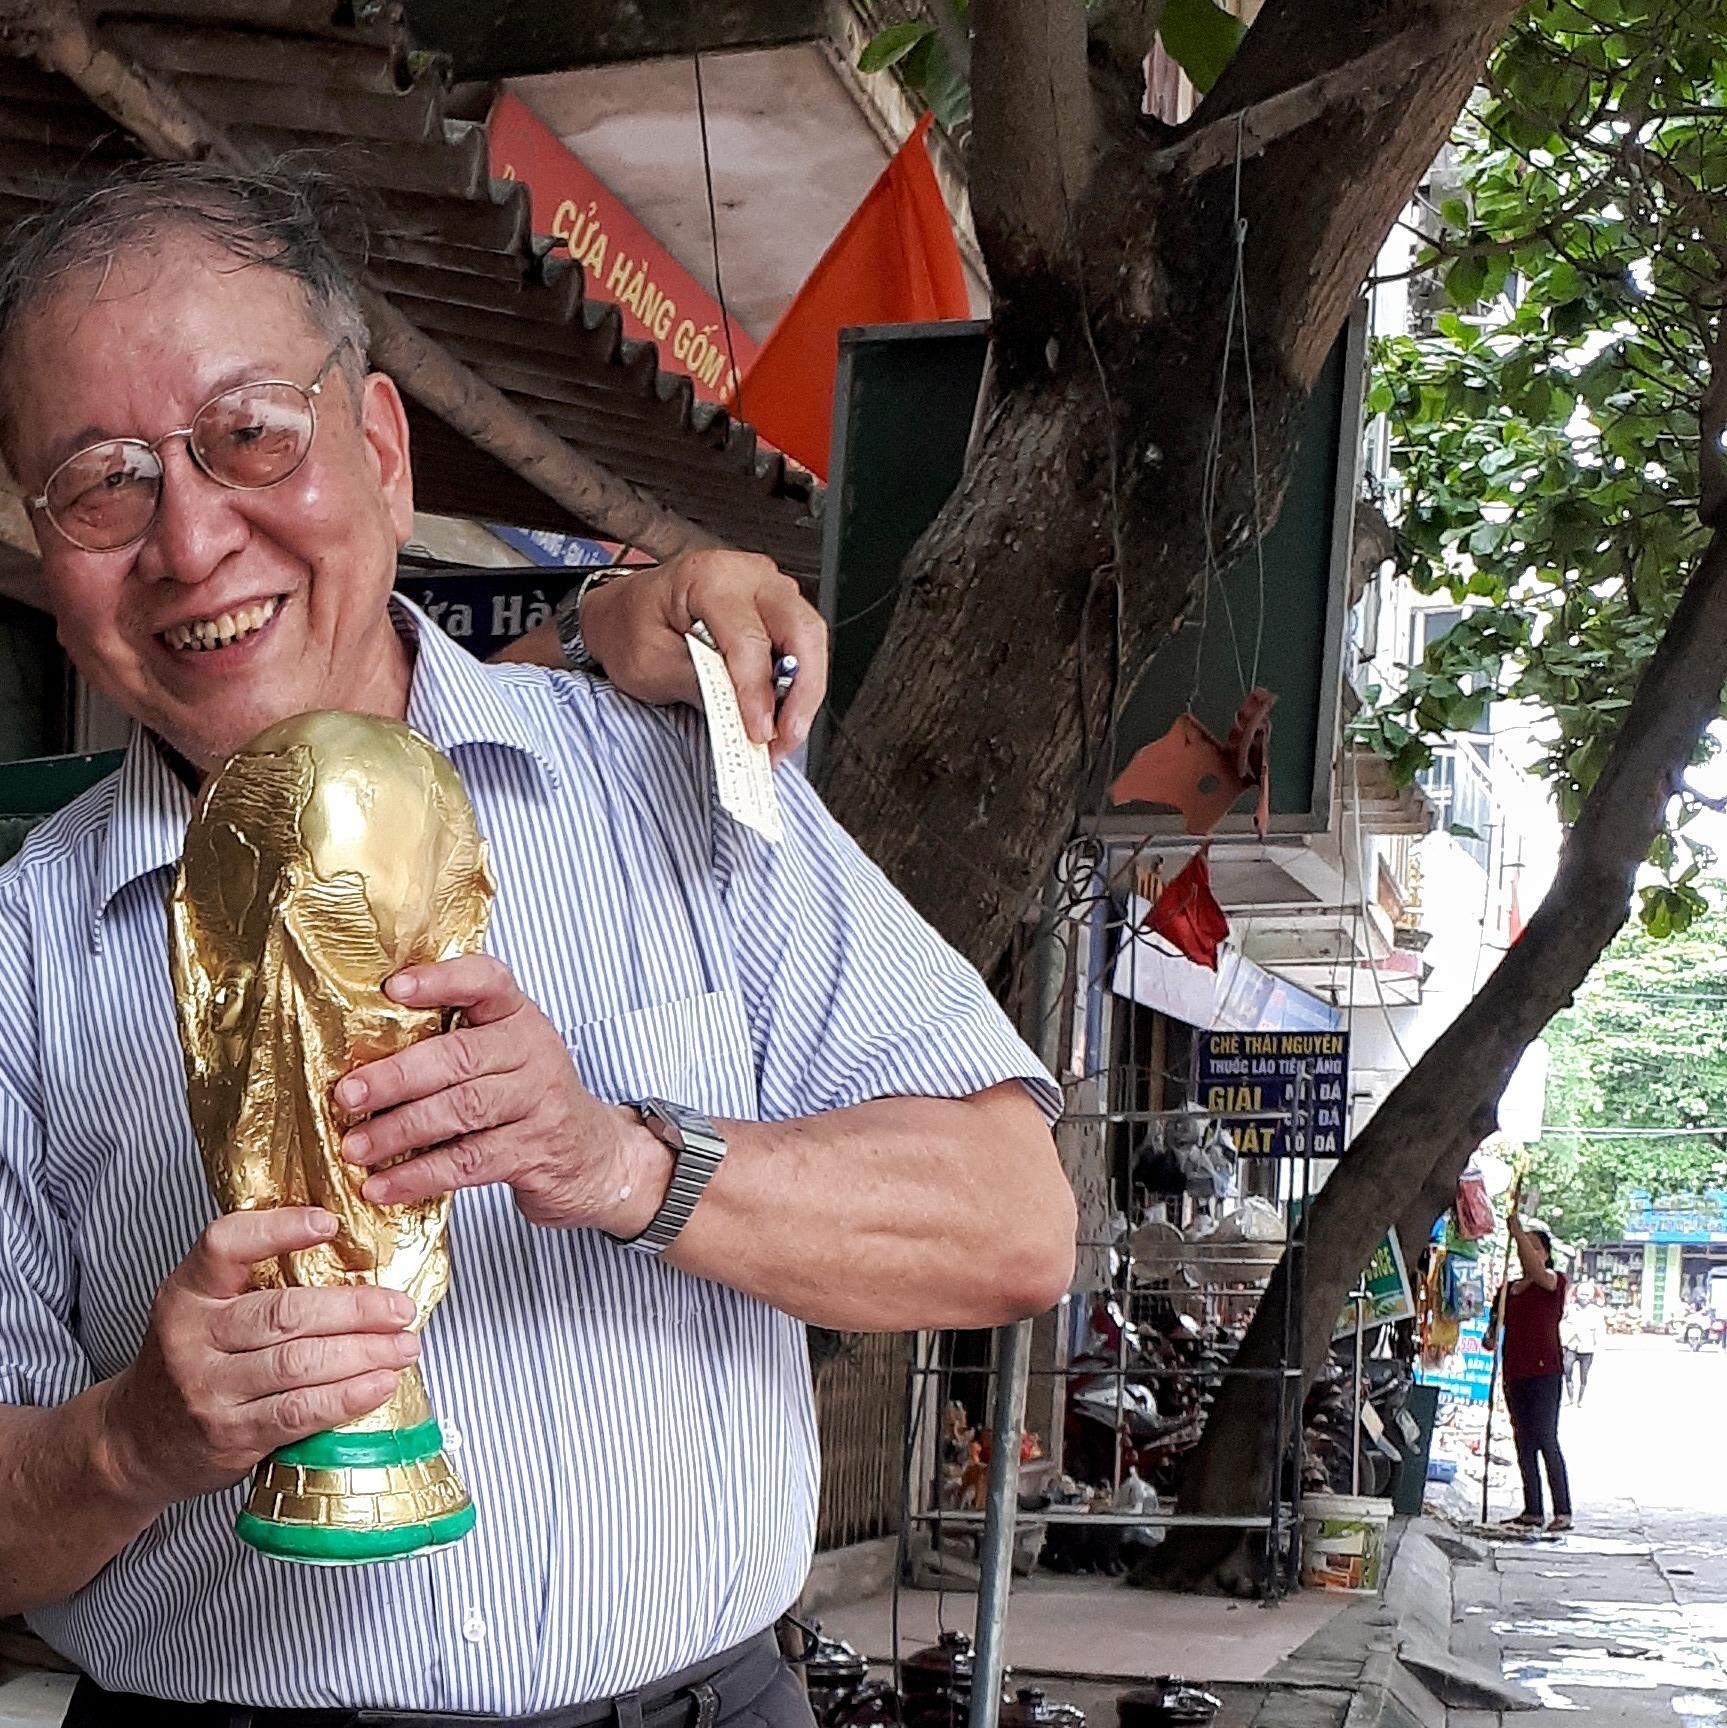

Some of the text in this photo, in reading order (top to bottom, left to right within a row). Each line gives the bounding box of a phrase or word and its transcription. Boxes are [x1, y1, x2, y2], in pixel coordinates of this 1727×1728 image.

[552, 199, 741, 401] CỬA HÀNG GỐM S
[490, 589, 552, 636] Hà
[1243, 1032, 1278, 1055] THÁI
[1280, 1032, 1344, 1055] NGUYÊN
[1208, 1077, 1263, 1112] GIẢI
